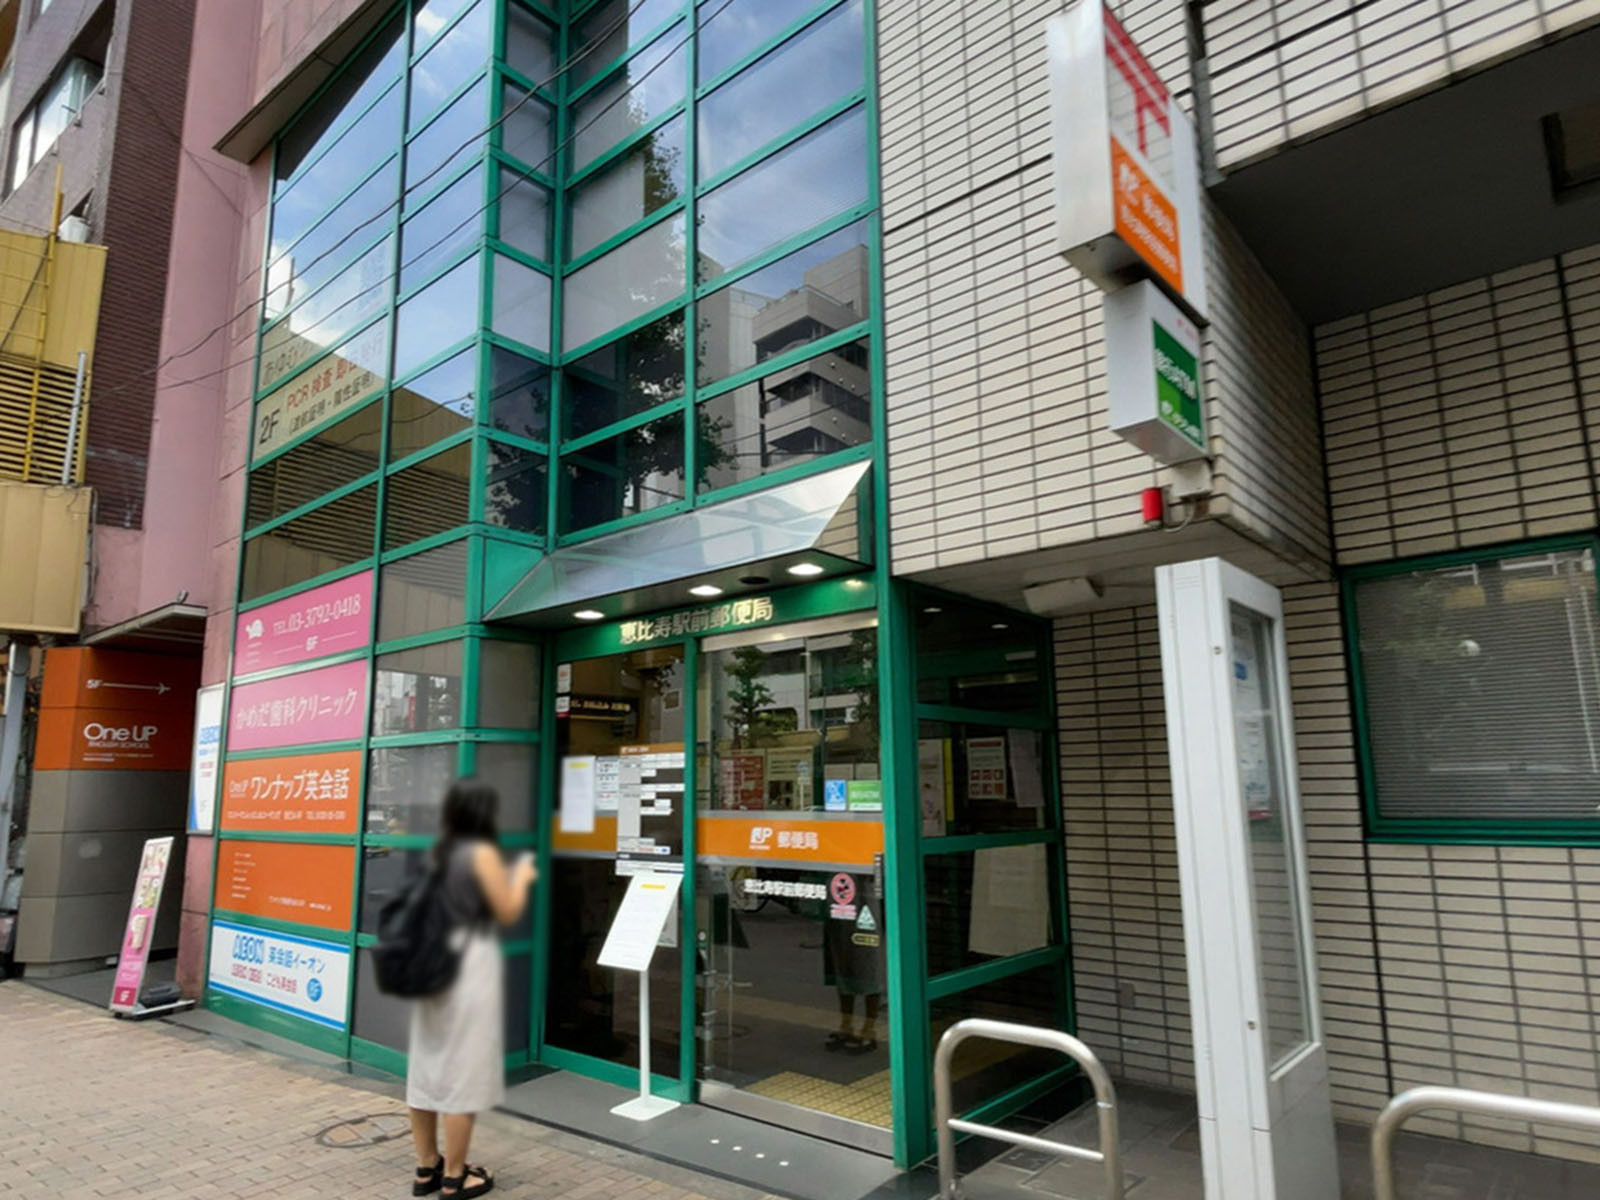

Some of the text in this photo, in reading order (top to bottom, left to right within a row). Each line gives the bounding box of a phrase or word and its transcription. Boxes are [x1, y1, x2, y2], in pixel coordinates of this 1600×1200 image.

[259, 408, 281, 445] 2F
[620, 597, 774, 645] 恵比寿駅前郵便局
[236, 688, 358, 730] かめだ歯科クリニック
[250, 768, 351, 800] ワンナップ英会話
[777, 831, 820, 850] 郵便局
